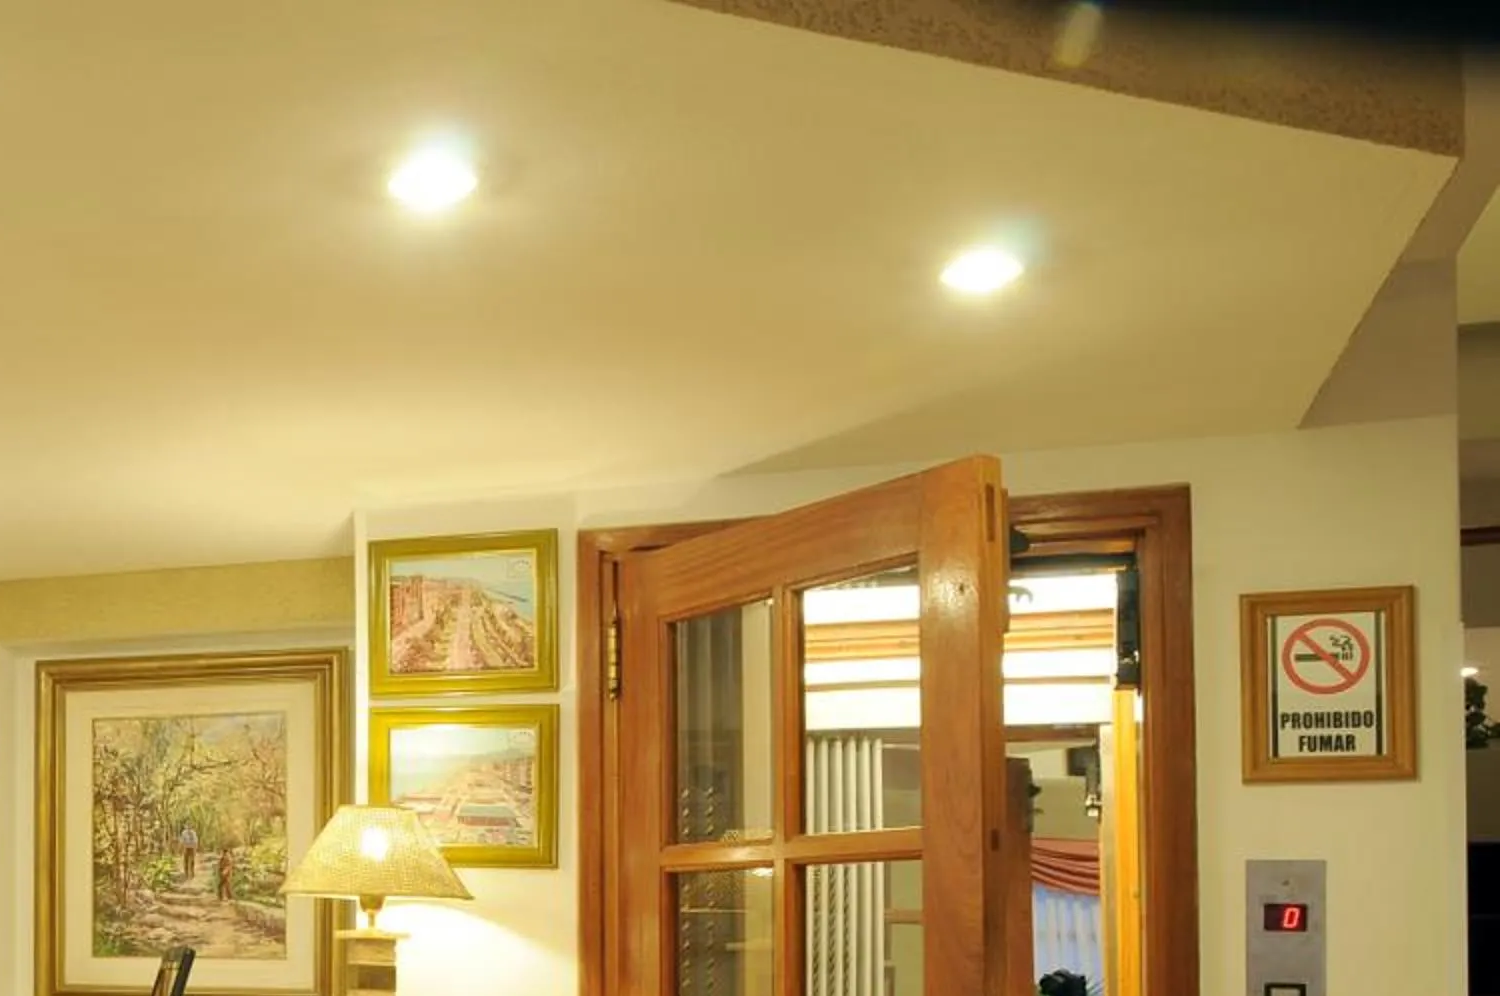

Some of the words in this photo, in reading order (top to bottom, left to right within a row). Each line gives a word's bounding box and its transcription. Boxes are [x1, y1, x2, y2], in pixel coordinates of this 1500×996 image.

[1280, 710, 1374, 729] PROHIBIDO
[1298, 734, 1356, 753] FUMAR
[1282, 907, 1300, 928] 0
